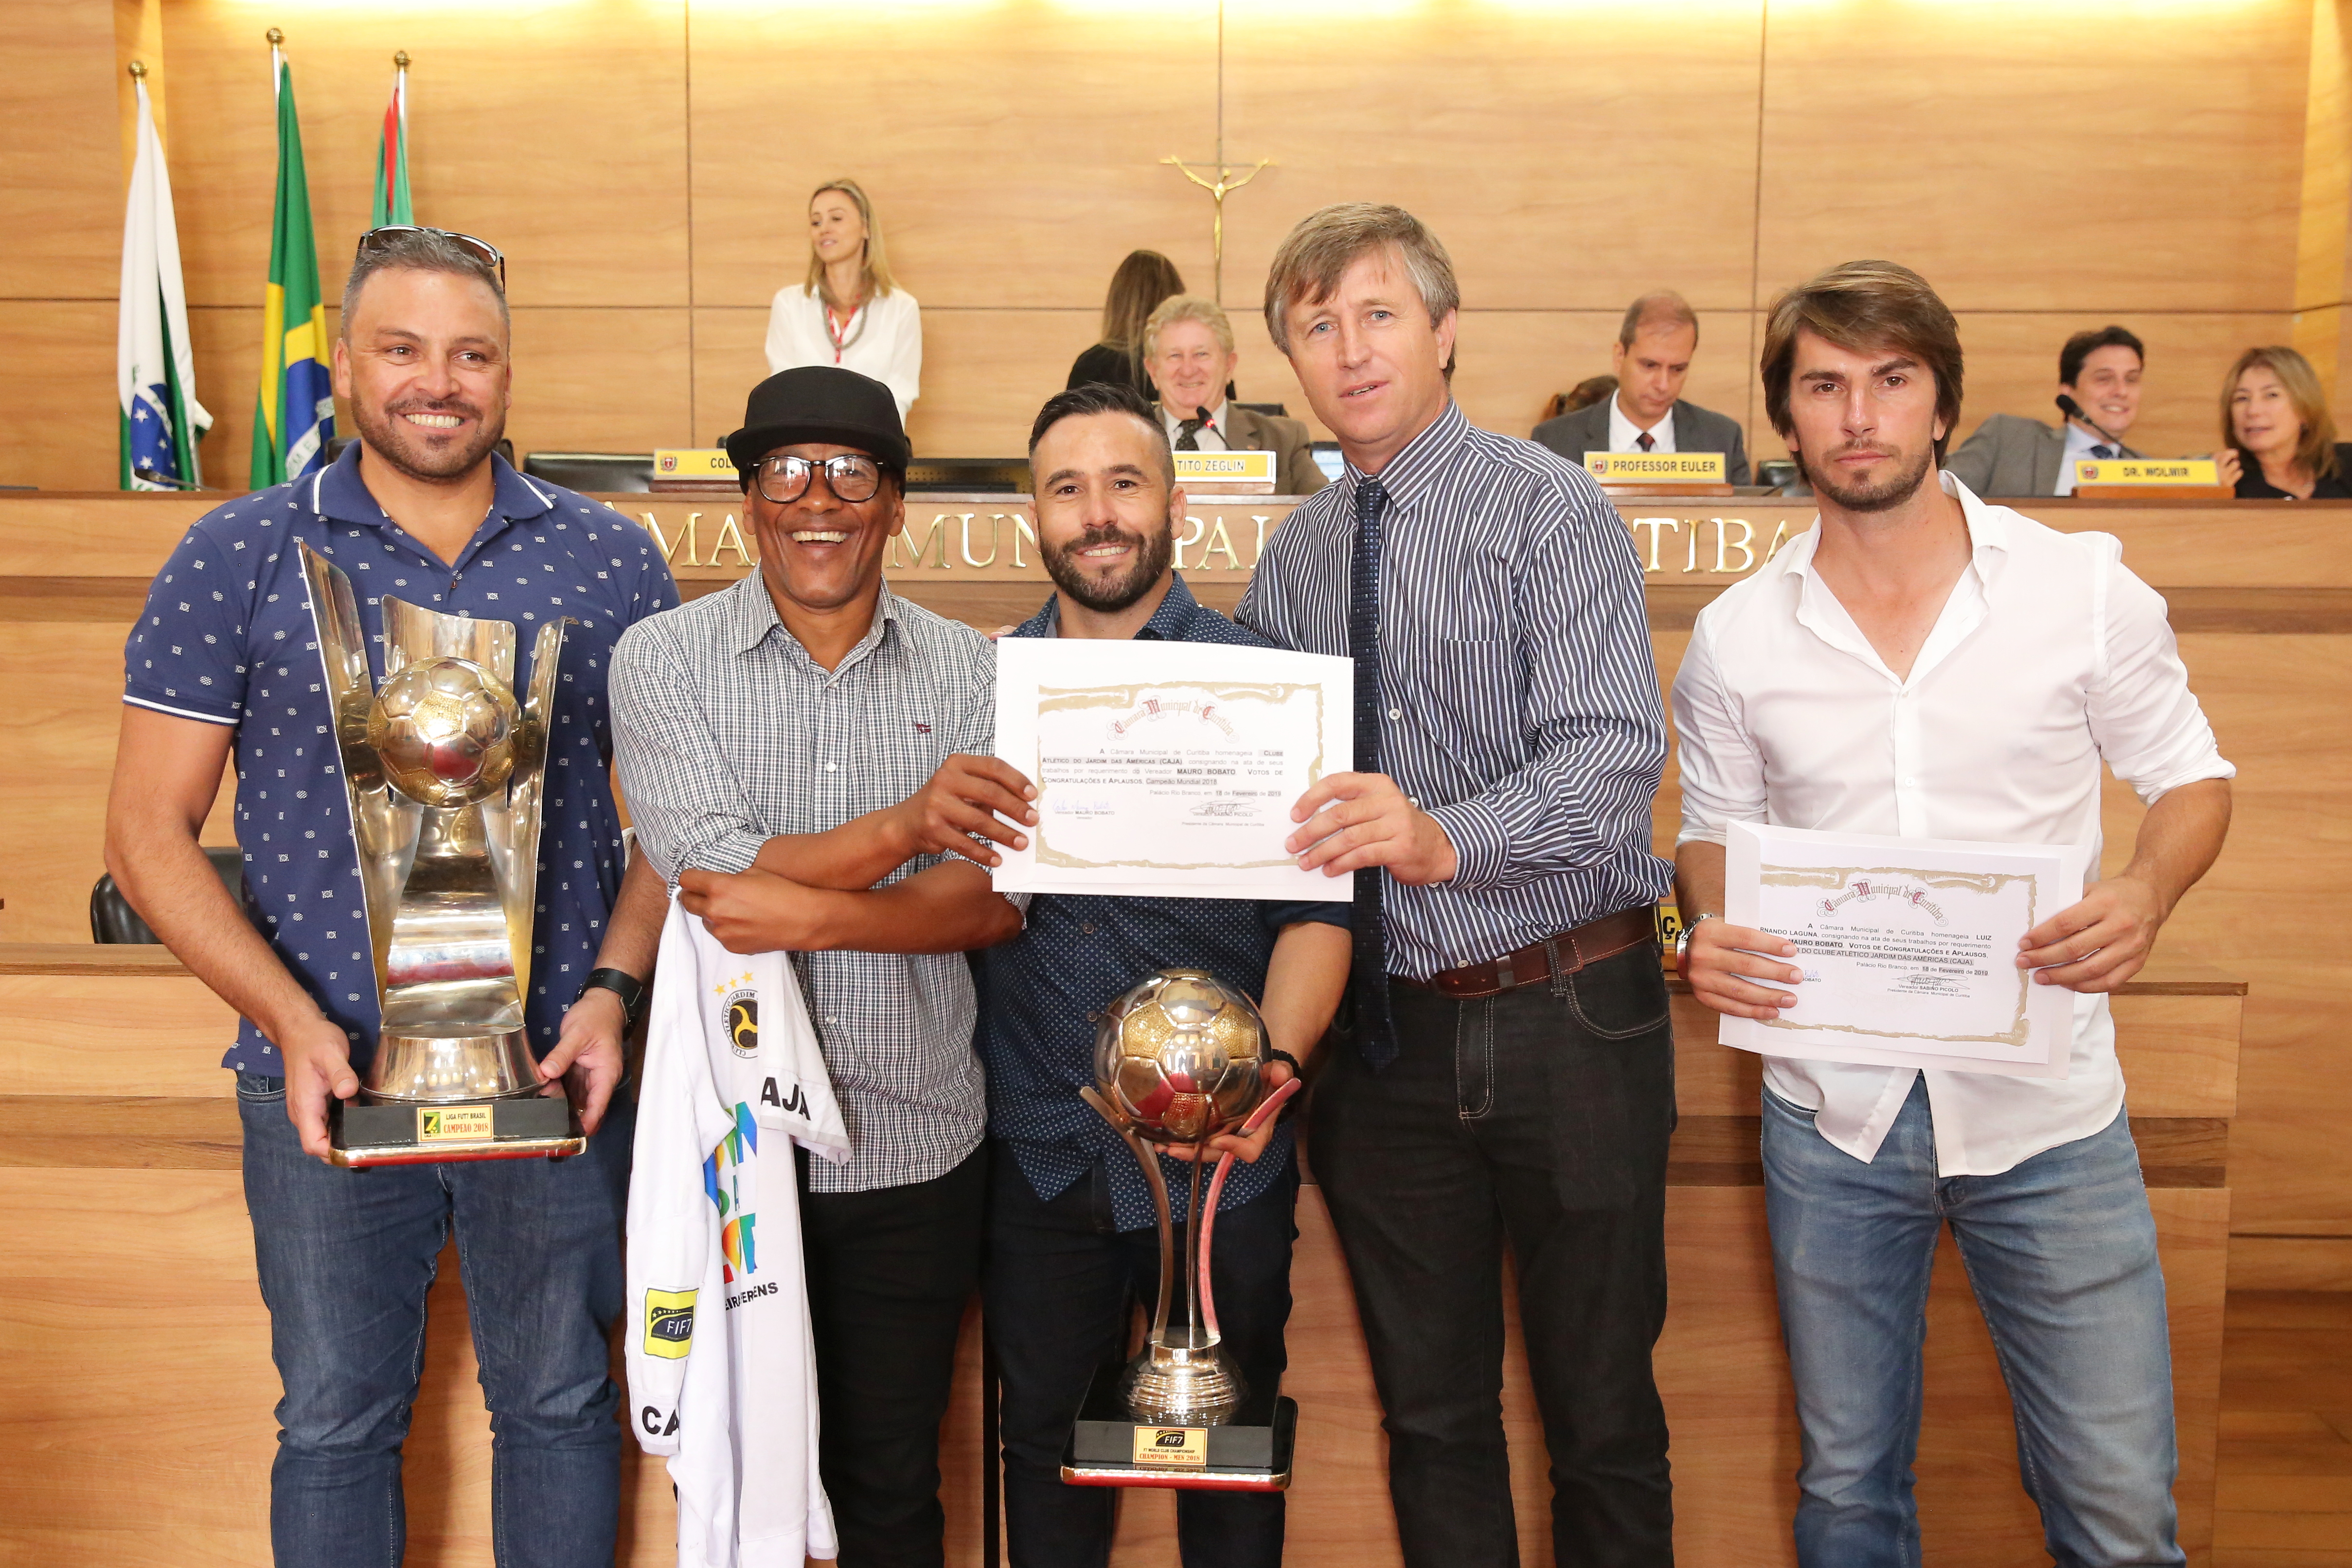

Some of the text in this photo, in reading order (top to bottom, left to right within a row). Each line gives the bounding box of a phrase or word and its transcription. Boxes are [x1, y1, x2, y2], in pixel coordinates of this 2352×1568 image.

[711, 458, 734, 468] COL
[1177, 461, 1244, 470] TITO ZEGLIN
[1614, 461, 1715, 471] PROFESSOR EULER
[1884, 945, 1943, 955] CONGRATULAÇÕES
[760, 1076, 811, 1121] AJA
[474, 1123, 489, 1132] 2018
[666, 1318, 692, 1335] FIF7
[641, 1406, 679, 1436] CA
[1164, 1436, 1183, 1444] FIF7
